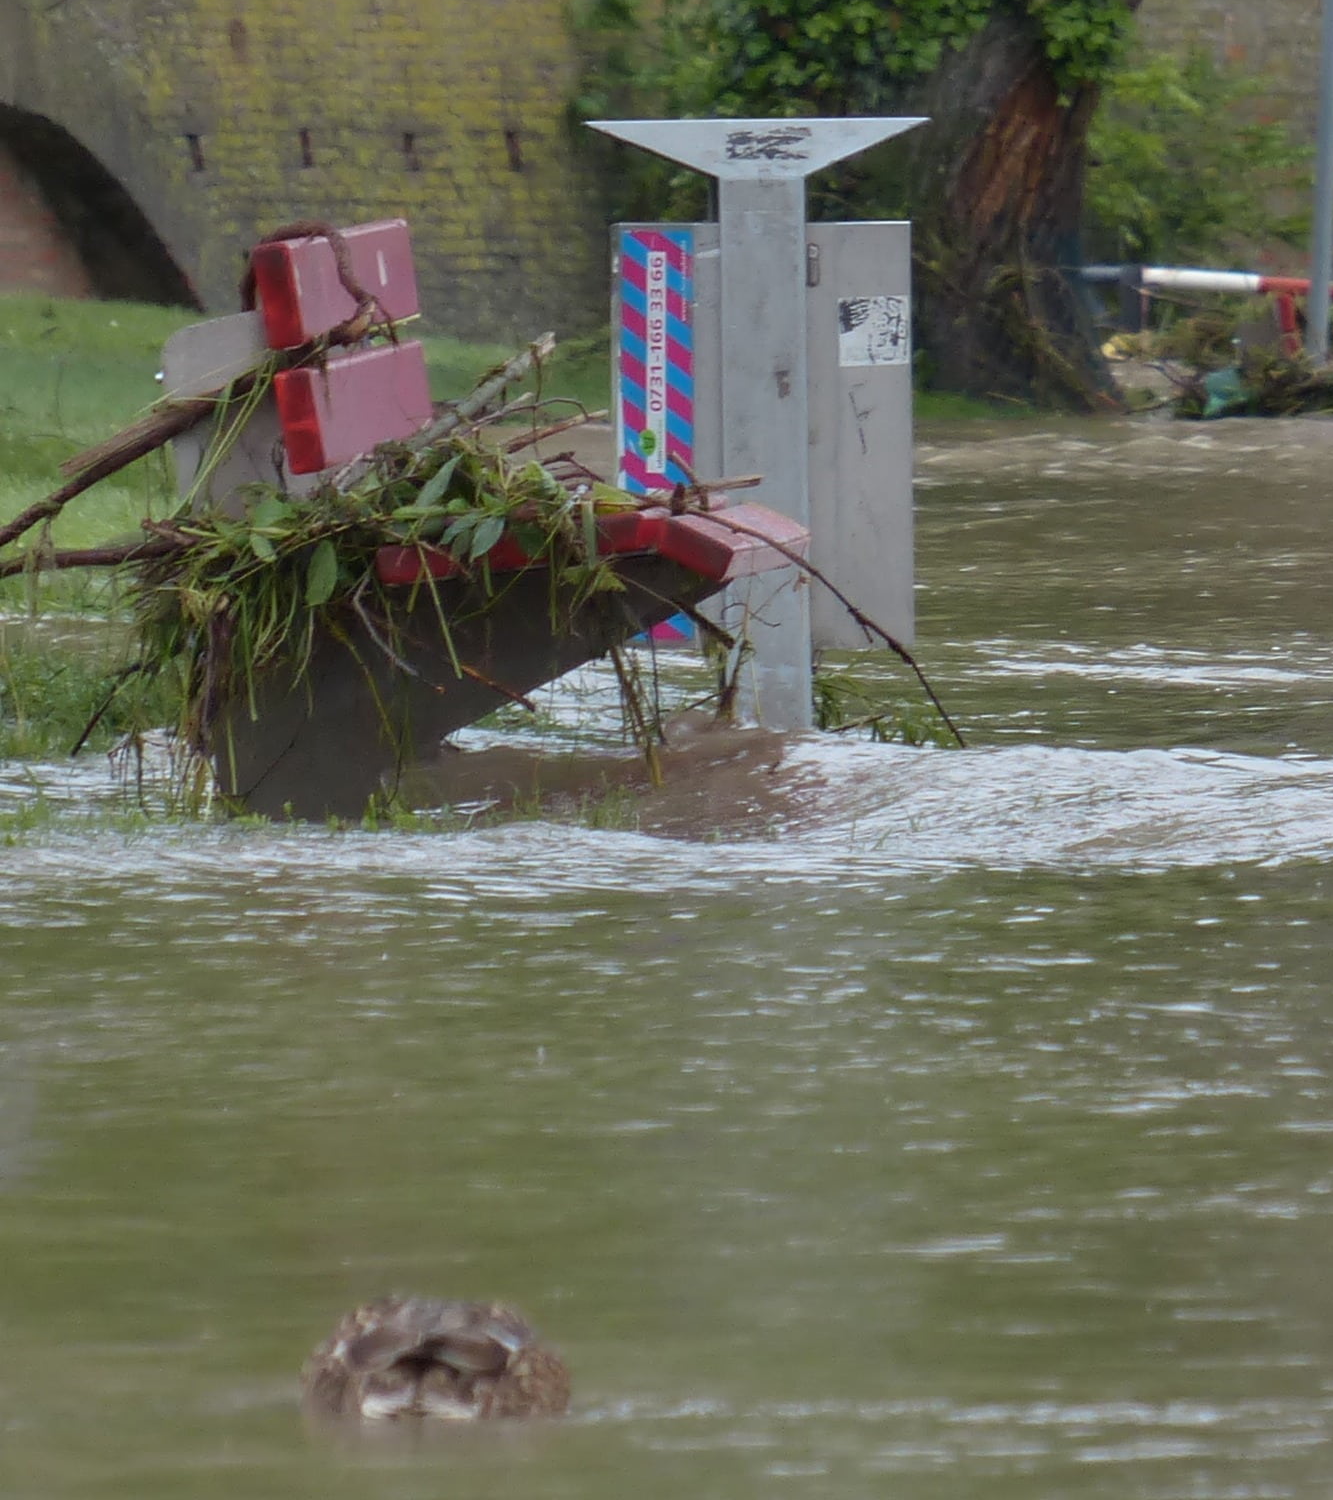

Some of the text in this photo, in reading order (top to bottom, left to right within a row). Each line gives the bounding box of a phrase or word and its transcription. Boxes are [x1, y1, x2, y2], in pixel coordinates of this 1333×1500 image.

[650, 257, 663, 281] 66
[650, 288, 663, 312] 33
[650, 319, 663, 412] 0731-166
